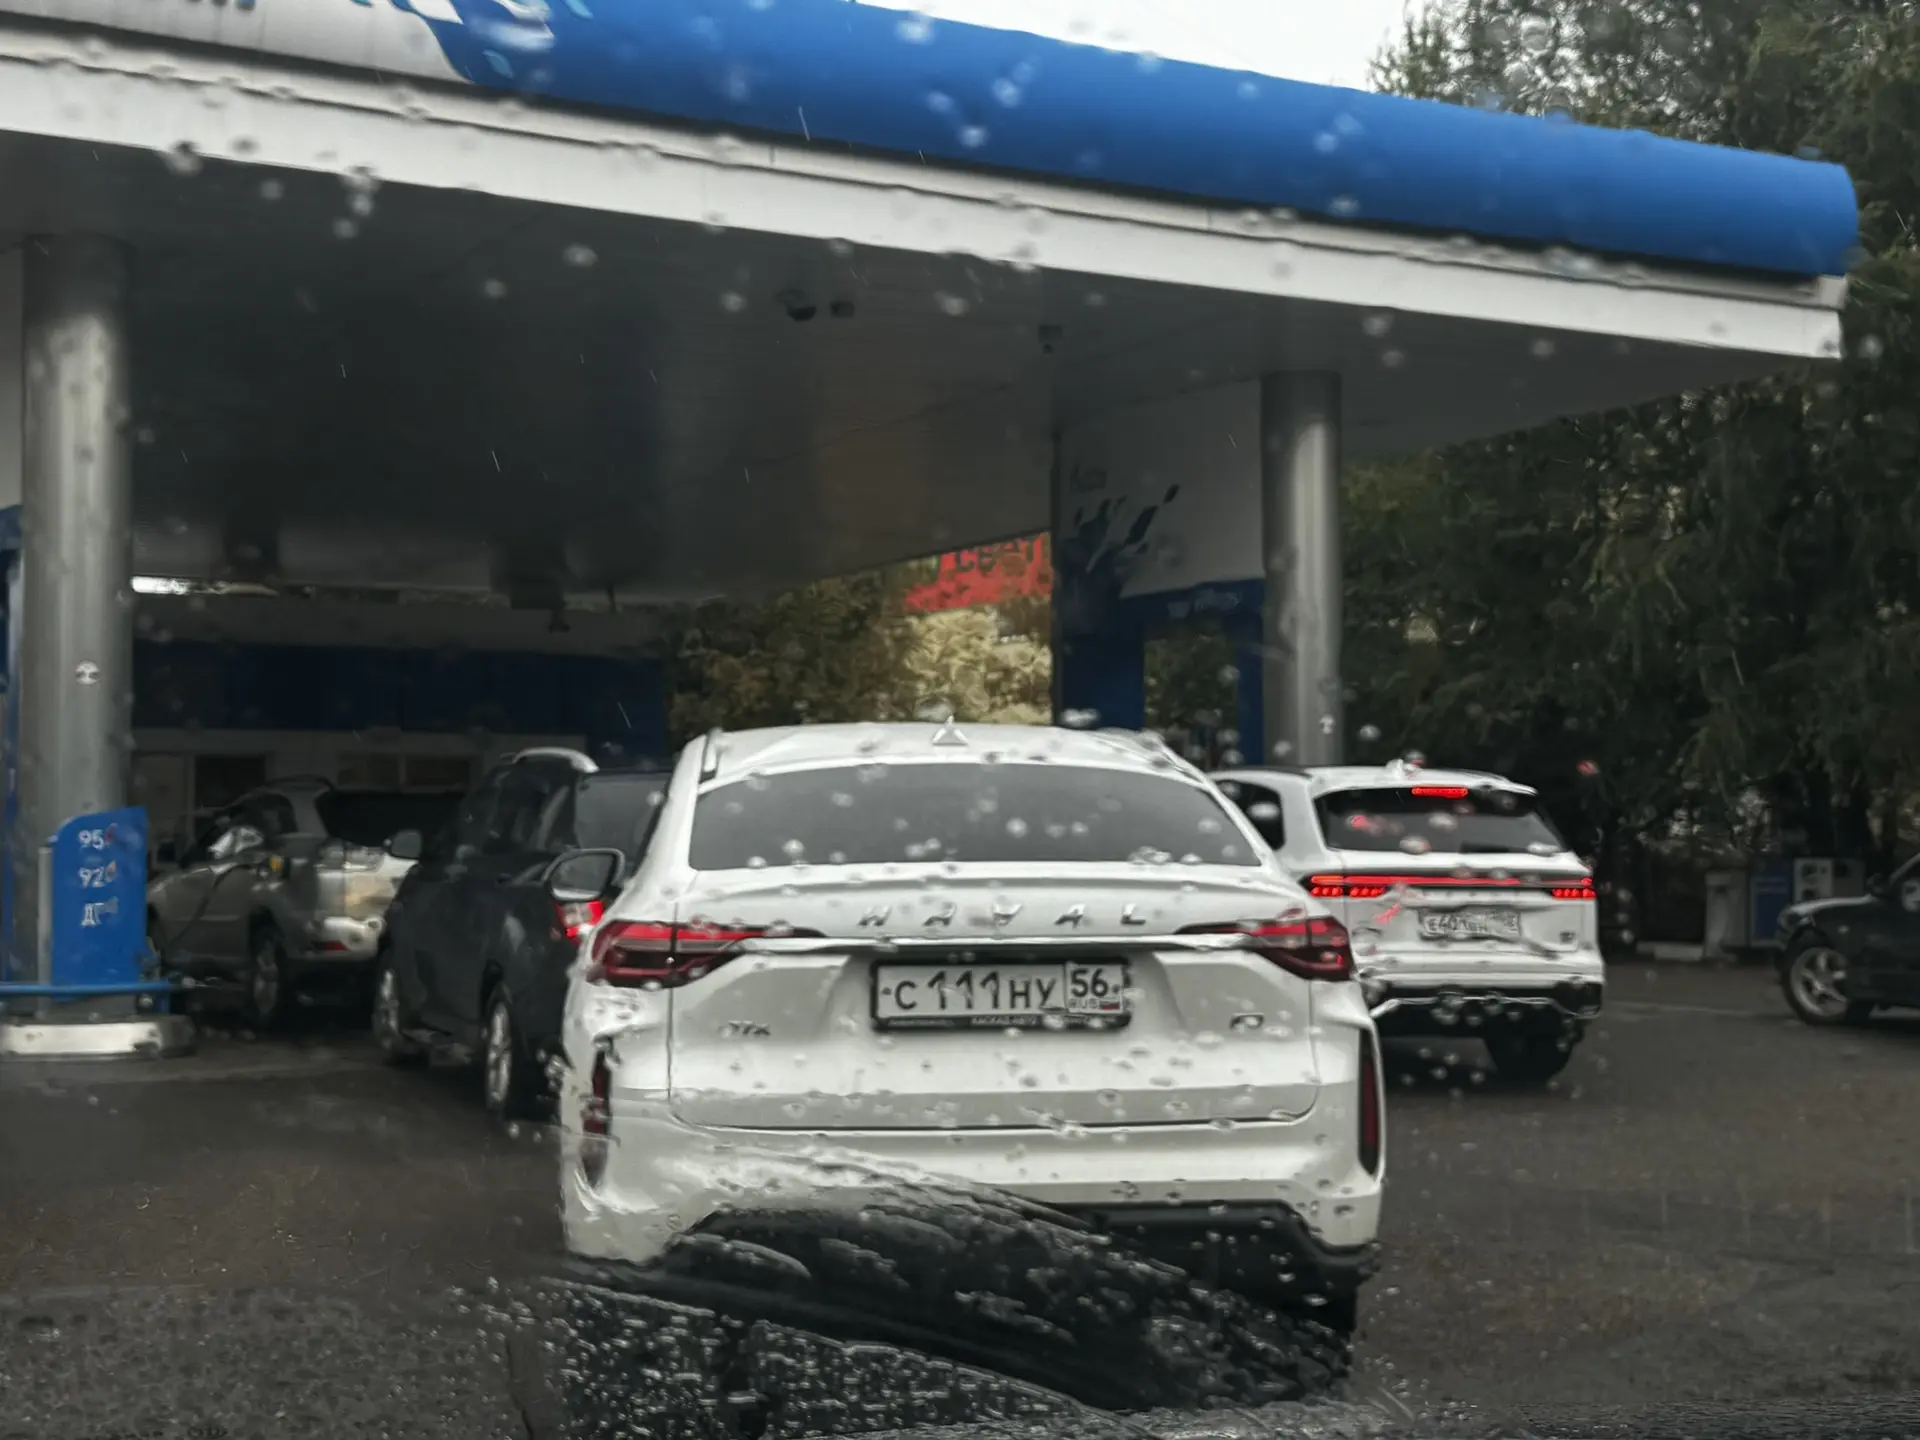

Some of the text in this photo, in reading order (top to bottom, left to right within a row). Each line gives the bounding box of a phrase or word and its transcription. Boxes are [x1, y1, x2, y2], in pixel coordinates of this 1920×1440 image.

[79, 829, 104, 850] 95
[79, 867, 104, 888] 92
[857, 902, 1147, 928] HAVAL
[1070, 967, 1109, 998] 56
